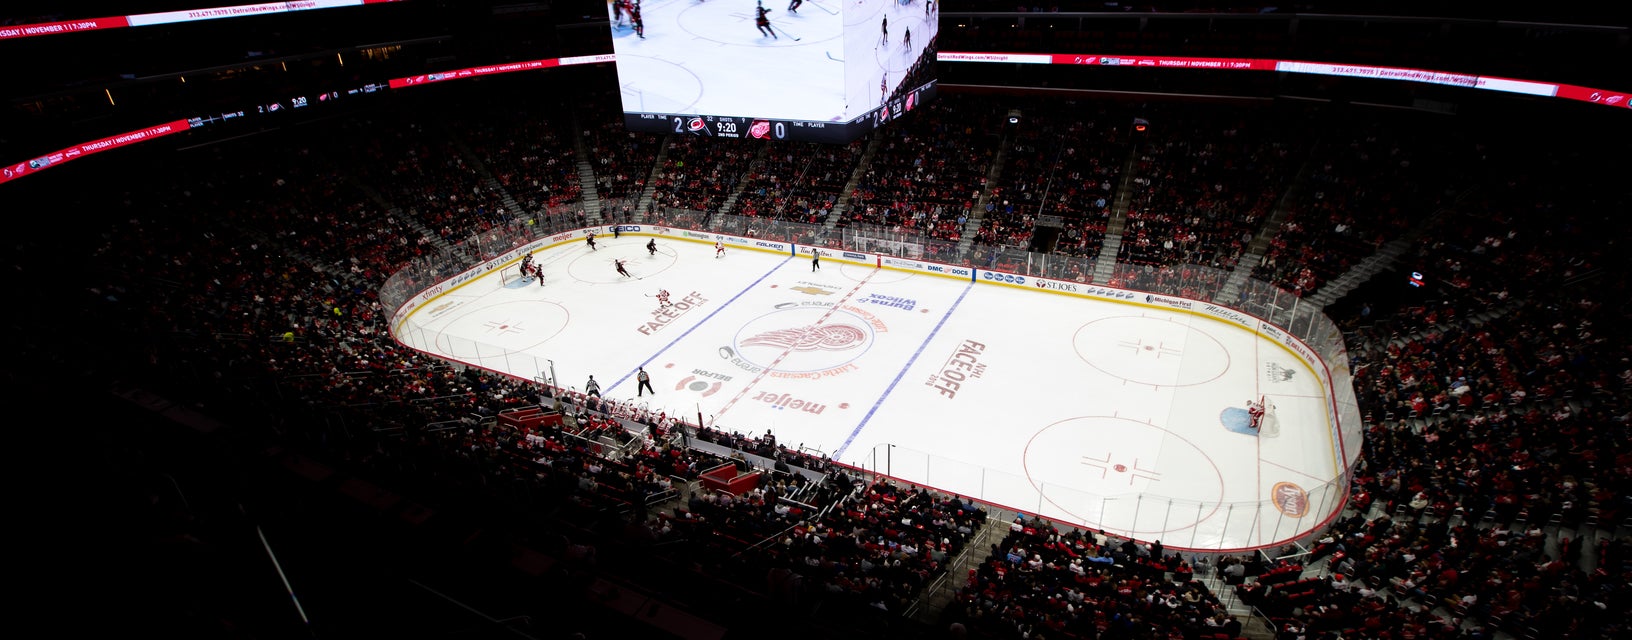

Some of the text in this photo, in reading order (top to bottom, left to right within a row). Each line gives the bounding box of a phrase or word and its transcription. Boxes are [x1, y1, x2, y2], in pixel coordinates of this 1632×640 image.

[25, 25, 62, 35] NOVEMBER
[291, 96, 307, 105] 9:20
[258, 105, 264, 113] 2
[673, 117, 684, 133] 2
[873, 111, 878, 128] 2
[717, 122, 737, 133] 9:20
[775, 122, 785, 138] 0
[82, 139, 112, 152] THURSDAY
[116, 132, 146, 144] NOVEMBER
[552, 232, 572, 242] meijer
[756, 241, 784, 249] FALKEN
[952, 268, 968, 276] DOCS
[422, 286, 443, 300] xfinity
[869, 293, 917, 305] Wilcox
[870, 300, 915, 311] Burns
[1154, 296, 1178, 305] Michigan
[731, 357, 761, 373] arena
[769, 363, 860, 380] Little Caesars
[969, 363, 987, 378] NHL
[691, 368, 733, 382] BELFOR
[752, 390, 826, 415] meijer
